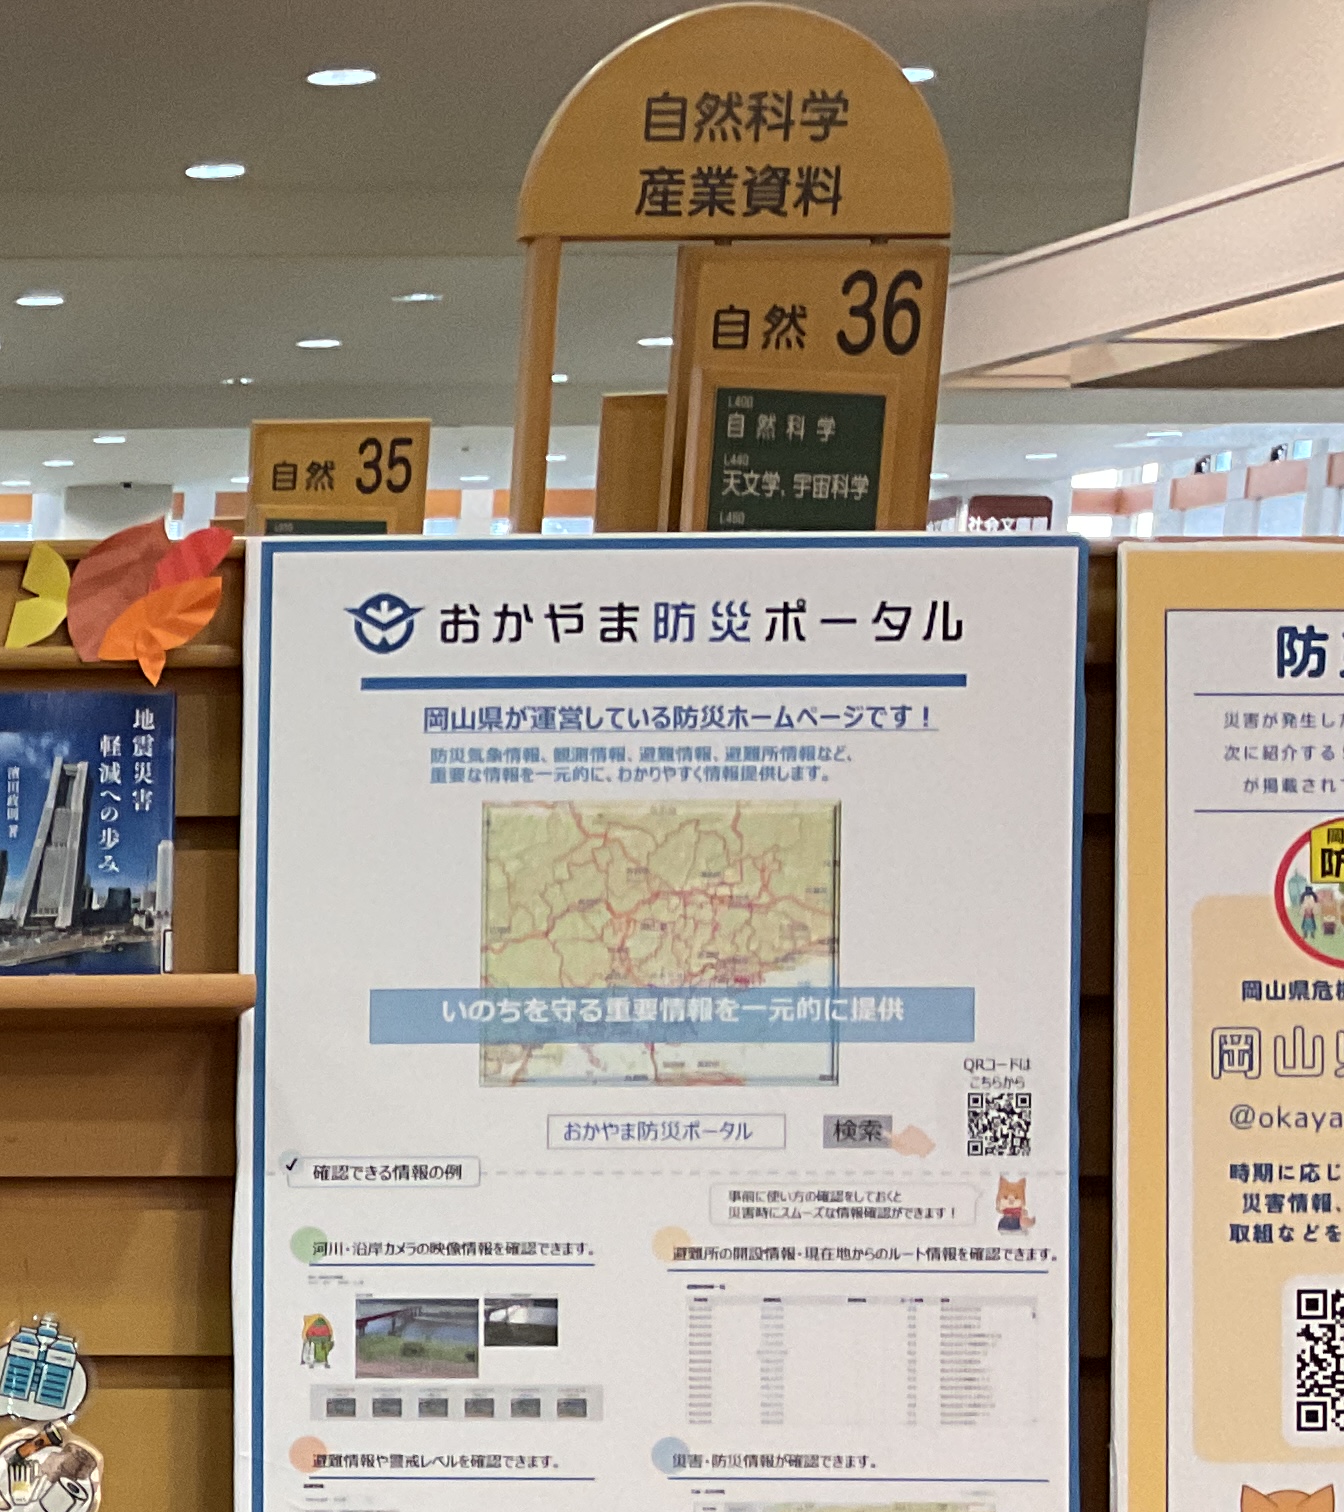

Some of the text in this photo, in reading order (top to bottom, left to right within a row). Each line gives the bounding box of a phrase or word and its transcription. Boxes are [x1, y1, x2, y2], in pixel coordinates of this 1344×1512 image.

[643, 91, 848, 144] 自然科学
[635, 164, 842, 219] 産業資料
[712, 270, 923, 356] 自然 36
[726, 412, 835, 441] 自然科学
[273, 437, 412, 494] 自然 35
[439, 599, 963, 645] おかやま防災ポータル
[424, 705, 931, 732] 岡山県が運営している防災ホームページです！
[133, 708, 155, 812] 地震災害
[99, 734, 121, 873] 軽減への歩み
[442, 994, 904, 1025] いのちを守る重要情報を一元的に提供
[563, 1120, 753, 1142] おかやま防災ポータル
[833, 1119, 884, 1142] 検索
[313, 1164, 462, 1181] 確認できる情報の例
[1230, 1161, 1342, 1183] 時期に応じ
[1230, 1224, 1342, 1244] 取組などを
